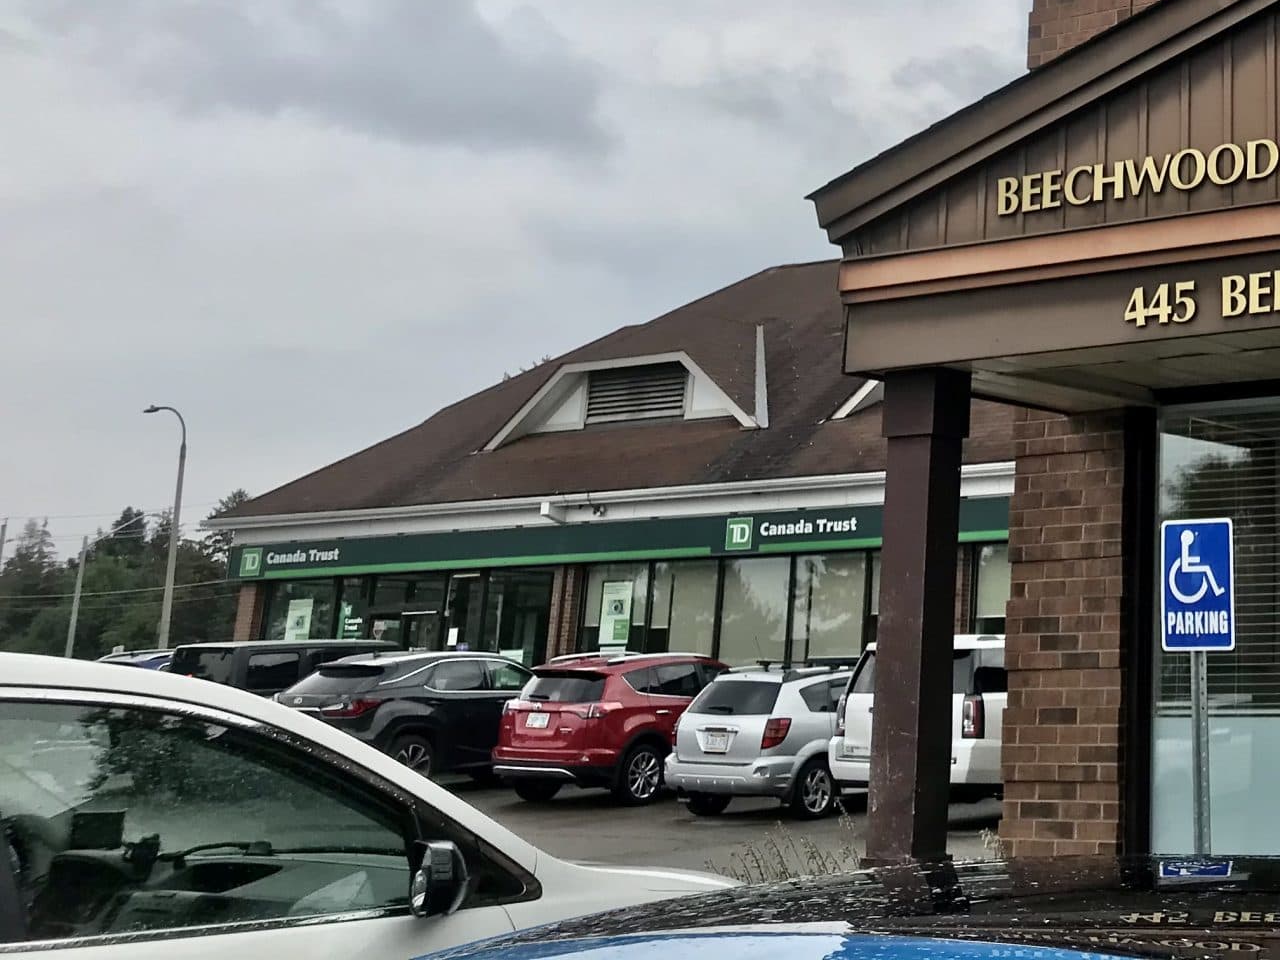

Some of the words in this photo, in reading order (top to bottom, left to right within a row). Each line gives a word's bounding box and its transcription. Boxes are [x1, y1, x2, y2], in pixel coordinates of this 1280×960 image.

[997, 139, 1280, 216] BEECHWOOD
[1124, 280, 1197, 327] 445
[729, 523, 750, 544] TD
[760, 519, 813, 536] Canada
[816, 517, 858, 533] Trust
[266, 550, 306, 565] Canada
[309, 548, 340, 562] Trust
[1167, 610, 1229, 636] PARKING
